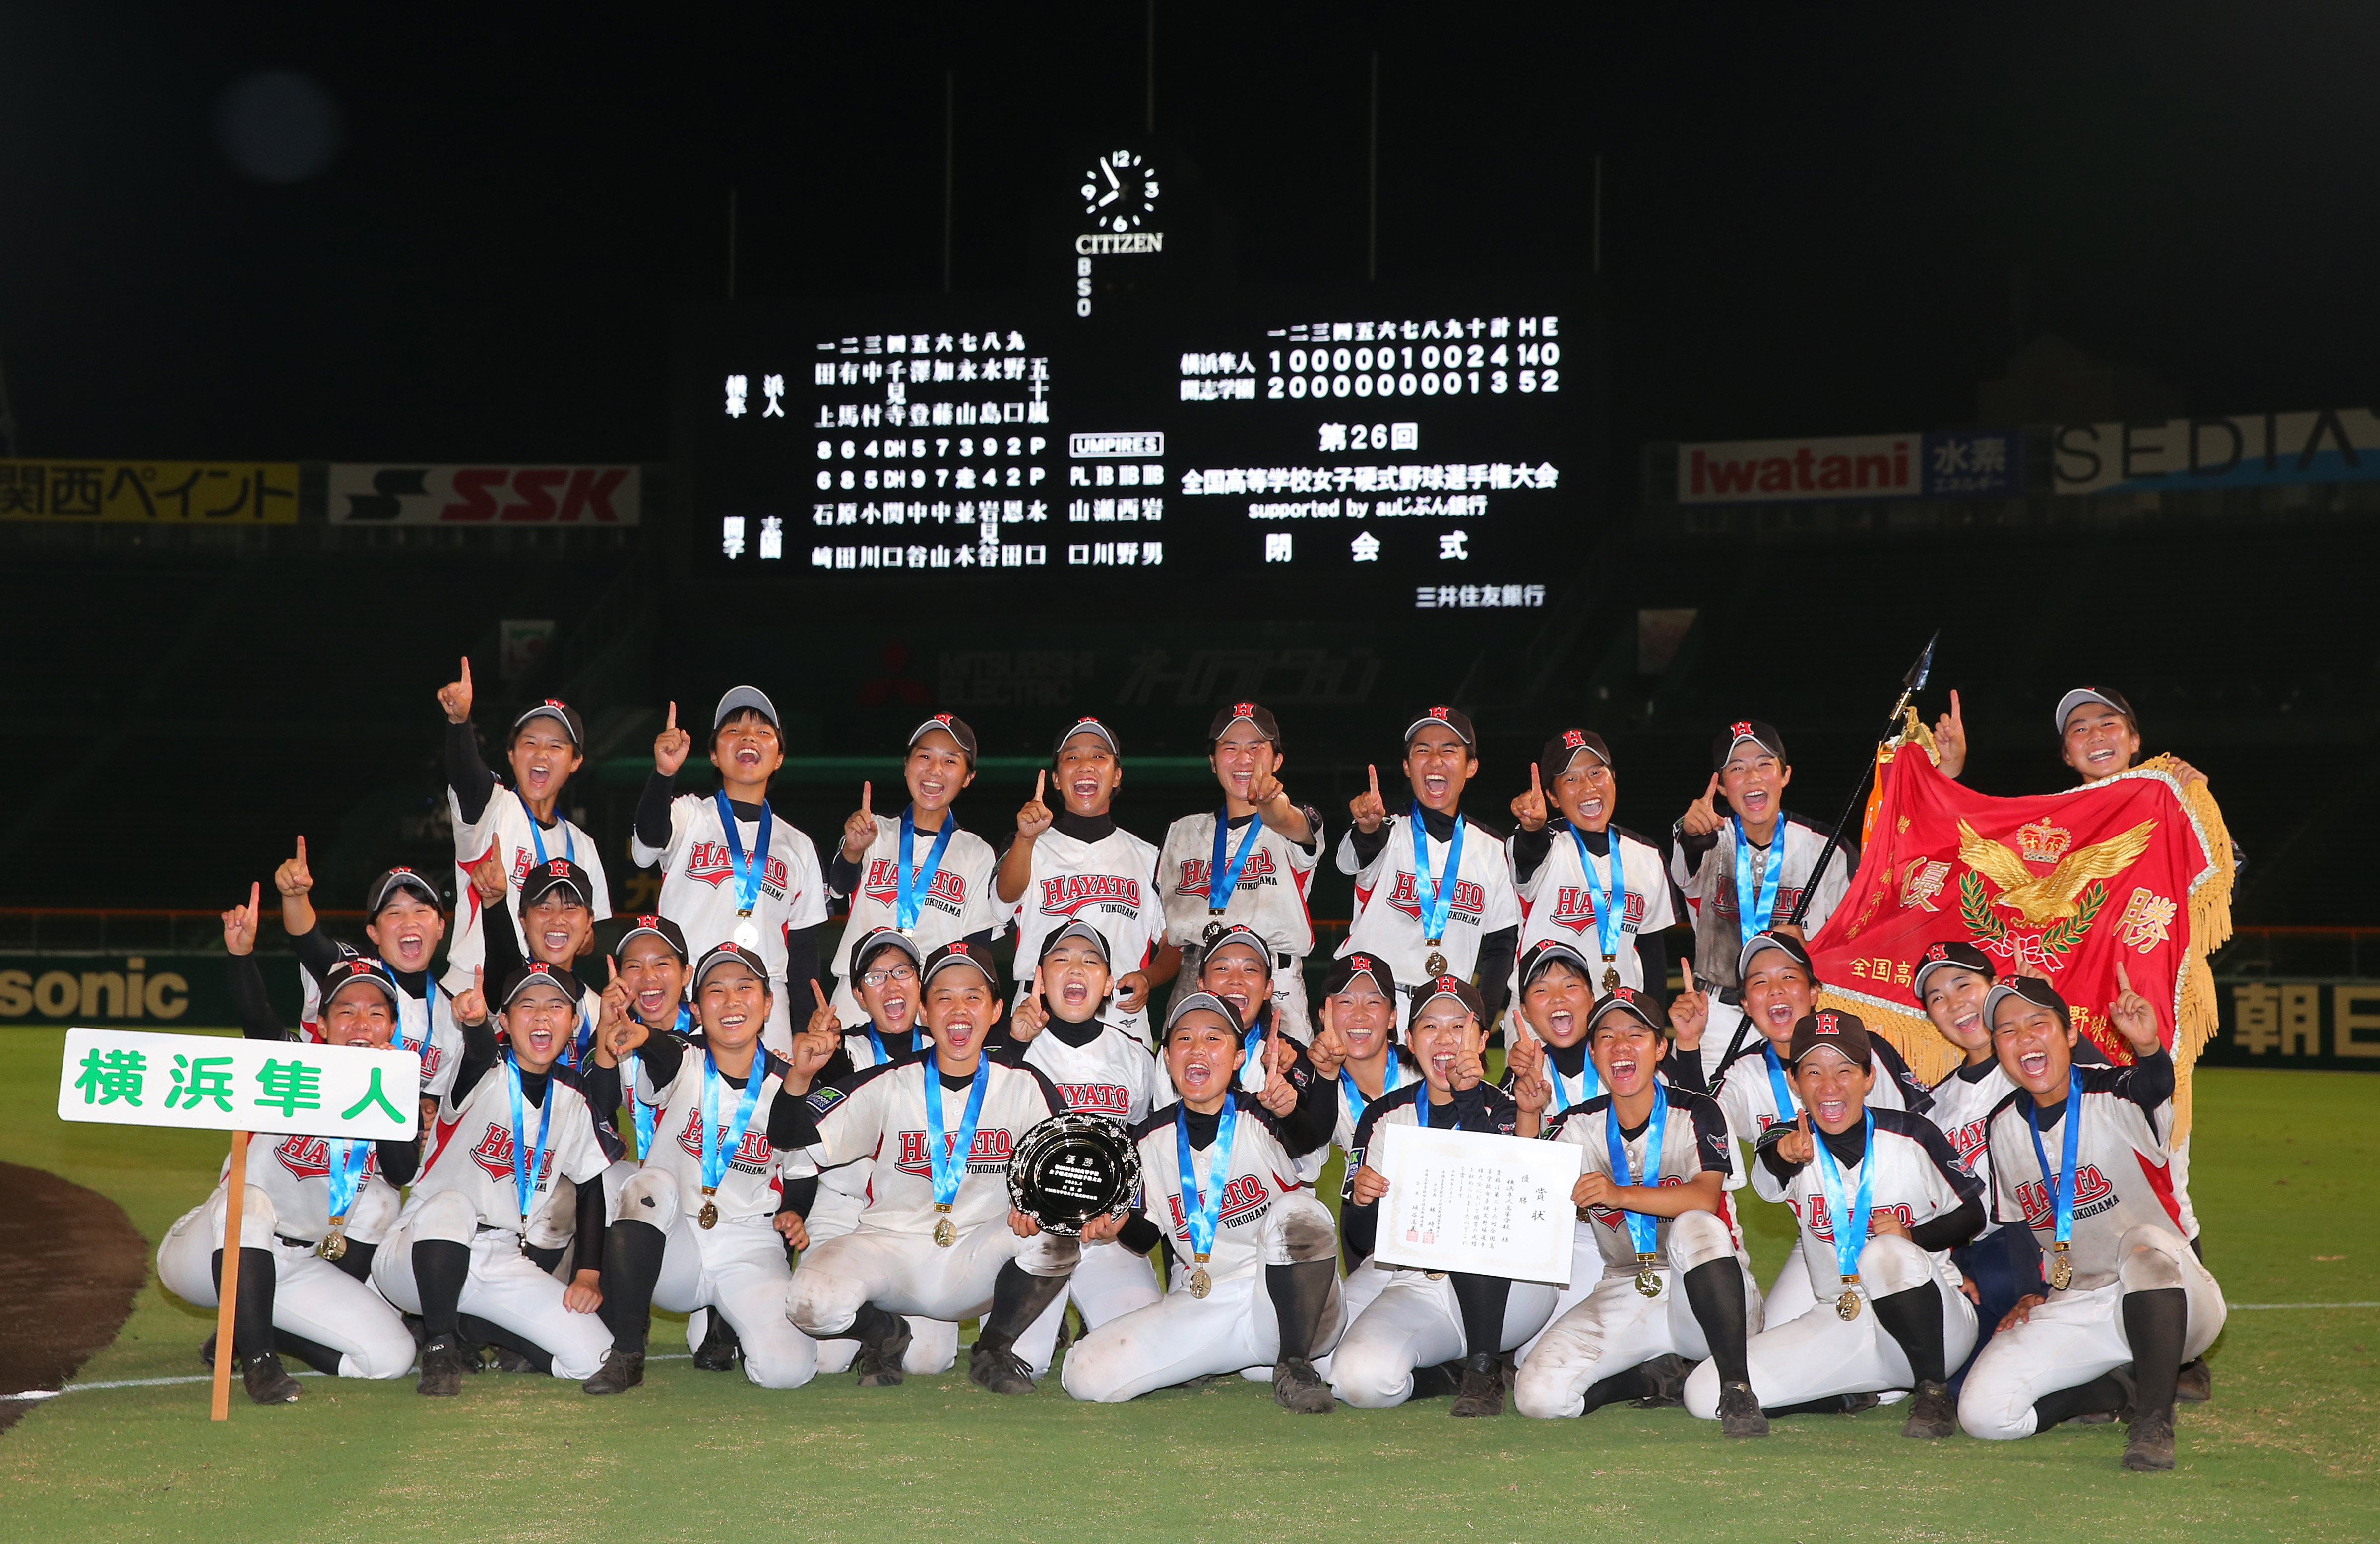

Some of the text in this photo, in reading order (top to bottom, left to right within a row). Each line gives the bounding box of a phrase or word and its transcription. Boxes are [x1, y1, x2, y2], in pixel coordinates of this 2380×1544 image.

[1112, 150, 1130, 167] 12
[1112, 215, 1128, 232] 6
[1075, 232, 1164, 255] CITIZEN
[1519, 317, 1537, 337] H
[1542, 316, 1558, 337] E
[1180, 352, 1256, 375] 横浜隼人
[1076, 437, 1157, 454] UMPIRES
[1318, 422, 1418, 452] 第26回
[1934, 438, 2006, 474] 水素
[1181, 461, 1559, 495] 全国高等学校女子硬式野球選手権大会
[1691, 441, 1908, 494] Iwatani
[0, 465, 294, 518] 関西ペイント
[440, 469, 629, 521] SSK
[1248, 499, 1340, 519] supported
[1345, 498, 1370, 518] by
[1416, 584, 1546, 608] 三井住友銀行
[938, 651, 1095, 678] MITSUBISHI
[938, 679, 1072, 705] ELECTRIC
[1233, 702, 1254, 718] H
[1429, 706, 1449, 720] H
[1562, 729, 1586, 749] H
[1730, 721, 1754, 740] H
[548, 860, 570, 877] H
[1041, 875, 1140, 907] HAYATO
[1236, 877, 1277, 891] YOKOAMA
[925, 898, 961, 917] OKOHAMA
[2113, 887, 2178, 954] 勝
[1352, 954, 1373, 971] H
[1925, 943, 1949, 962] H
[0, 957, 189, 1019] sonic
[1435, 975, 1457, 993] H
[1815, 1013, 1840, 1034] H
[75, 1048, 406, 1124] 横浜隼人
[729, 1161, 766, 1175] OKOHAMA
[966, 1164, 1008, 1175] YOKOHAM
[2073, 1195, 2120, 1221] OKOHAMA
